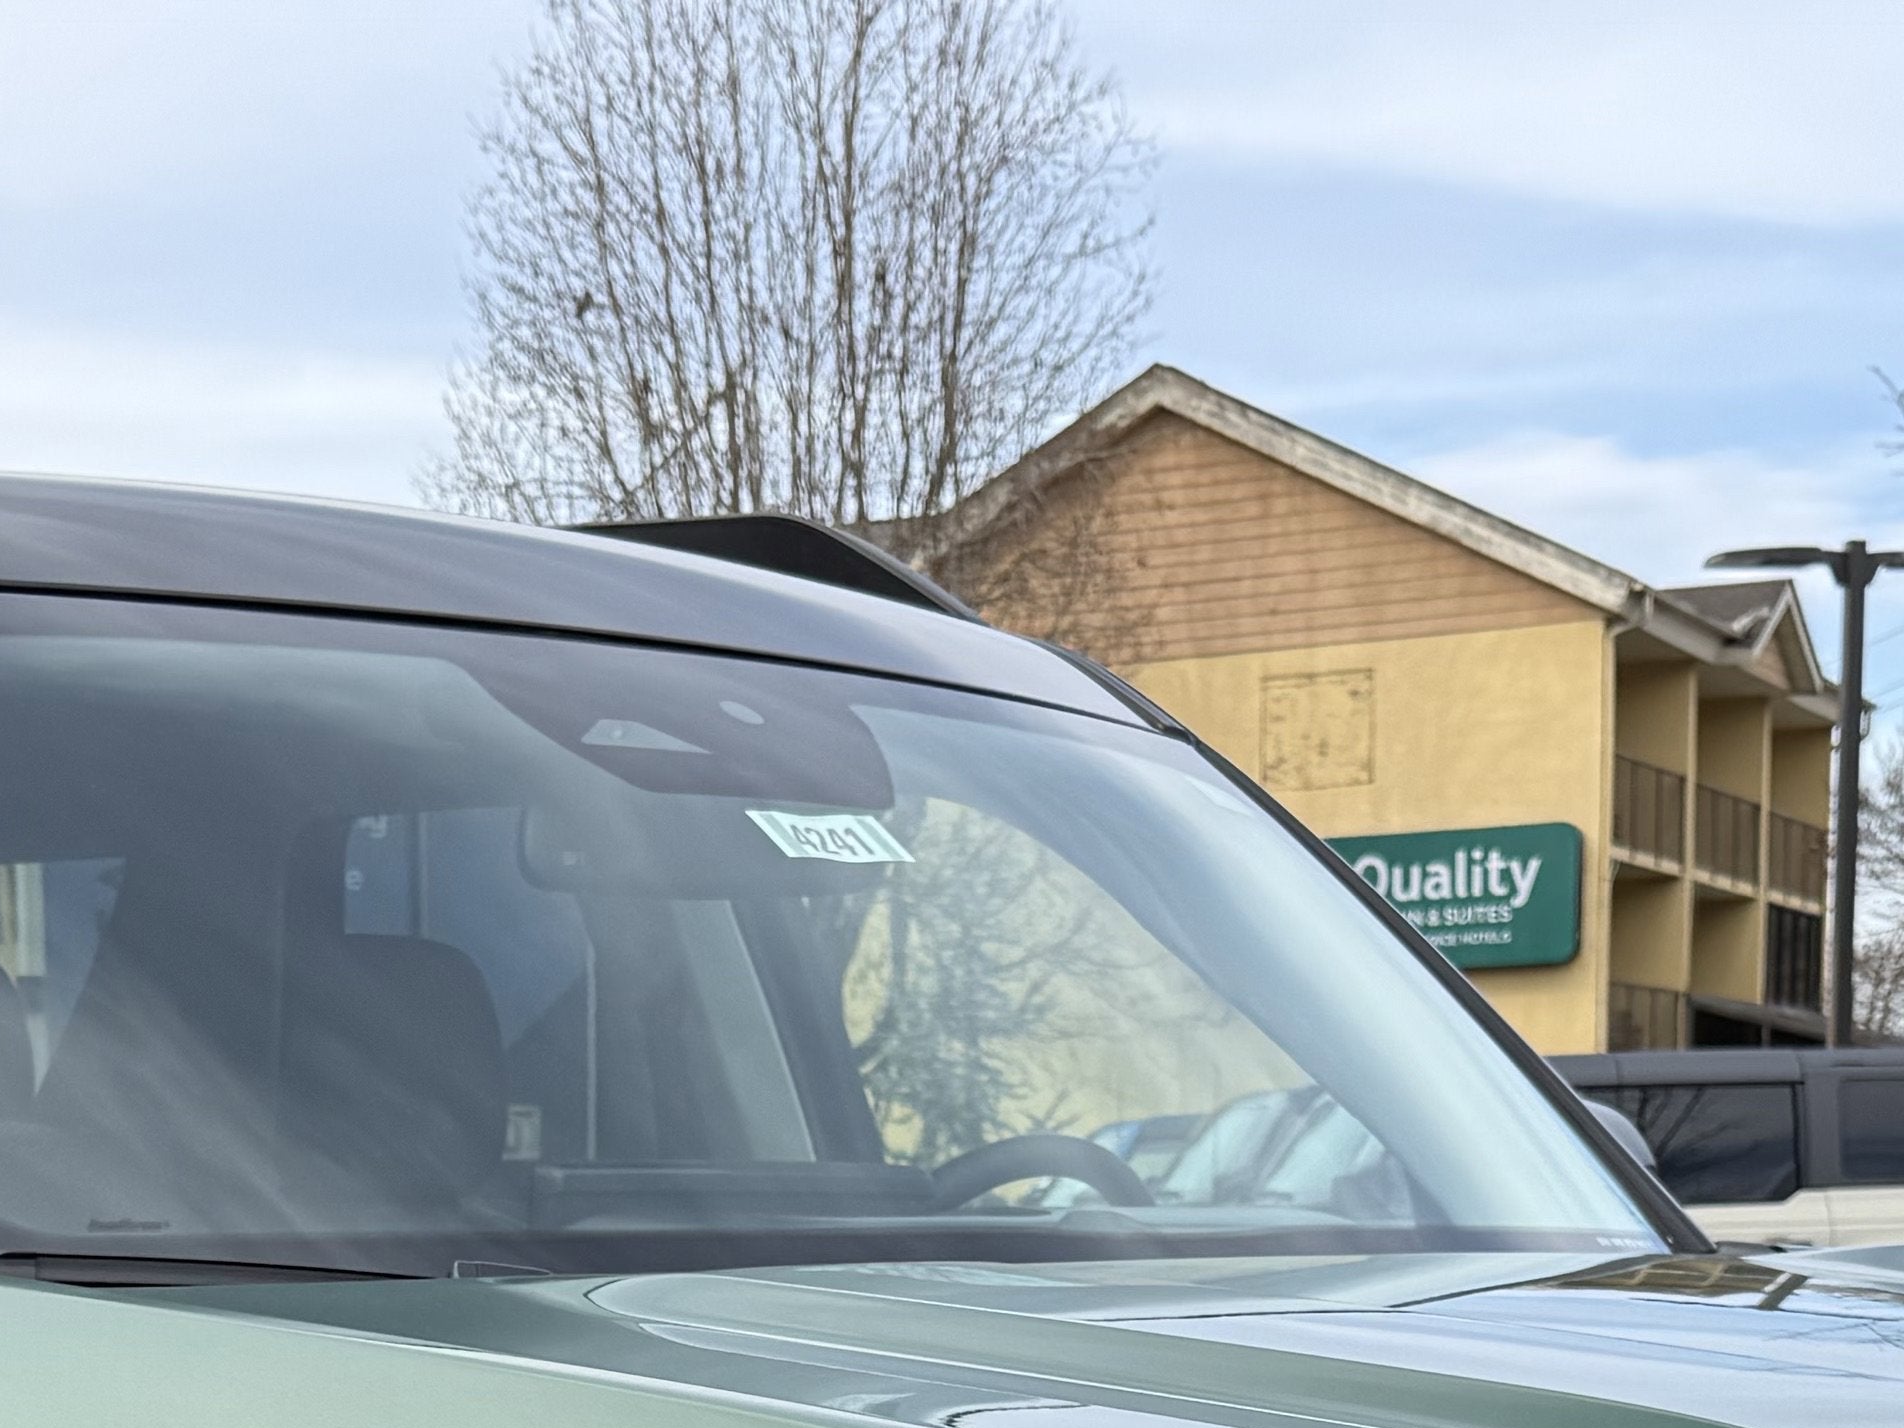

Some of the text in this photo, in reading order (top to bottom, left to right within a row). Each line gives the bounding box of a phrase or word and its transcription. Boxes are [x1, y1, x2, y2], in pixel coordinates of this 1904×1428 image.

[788, 823, 876, 857] 4241
[1351, 847, 1543, 909] Quality
[1442, 903, 1513, 926] SUITES
